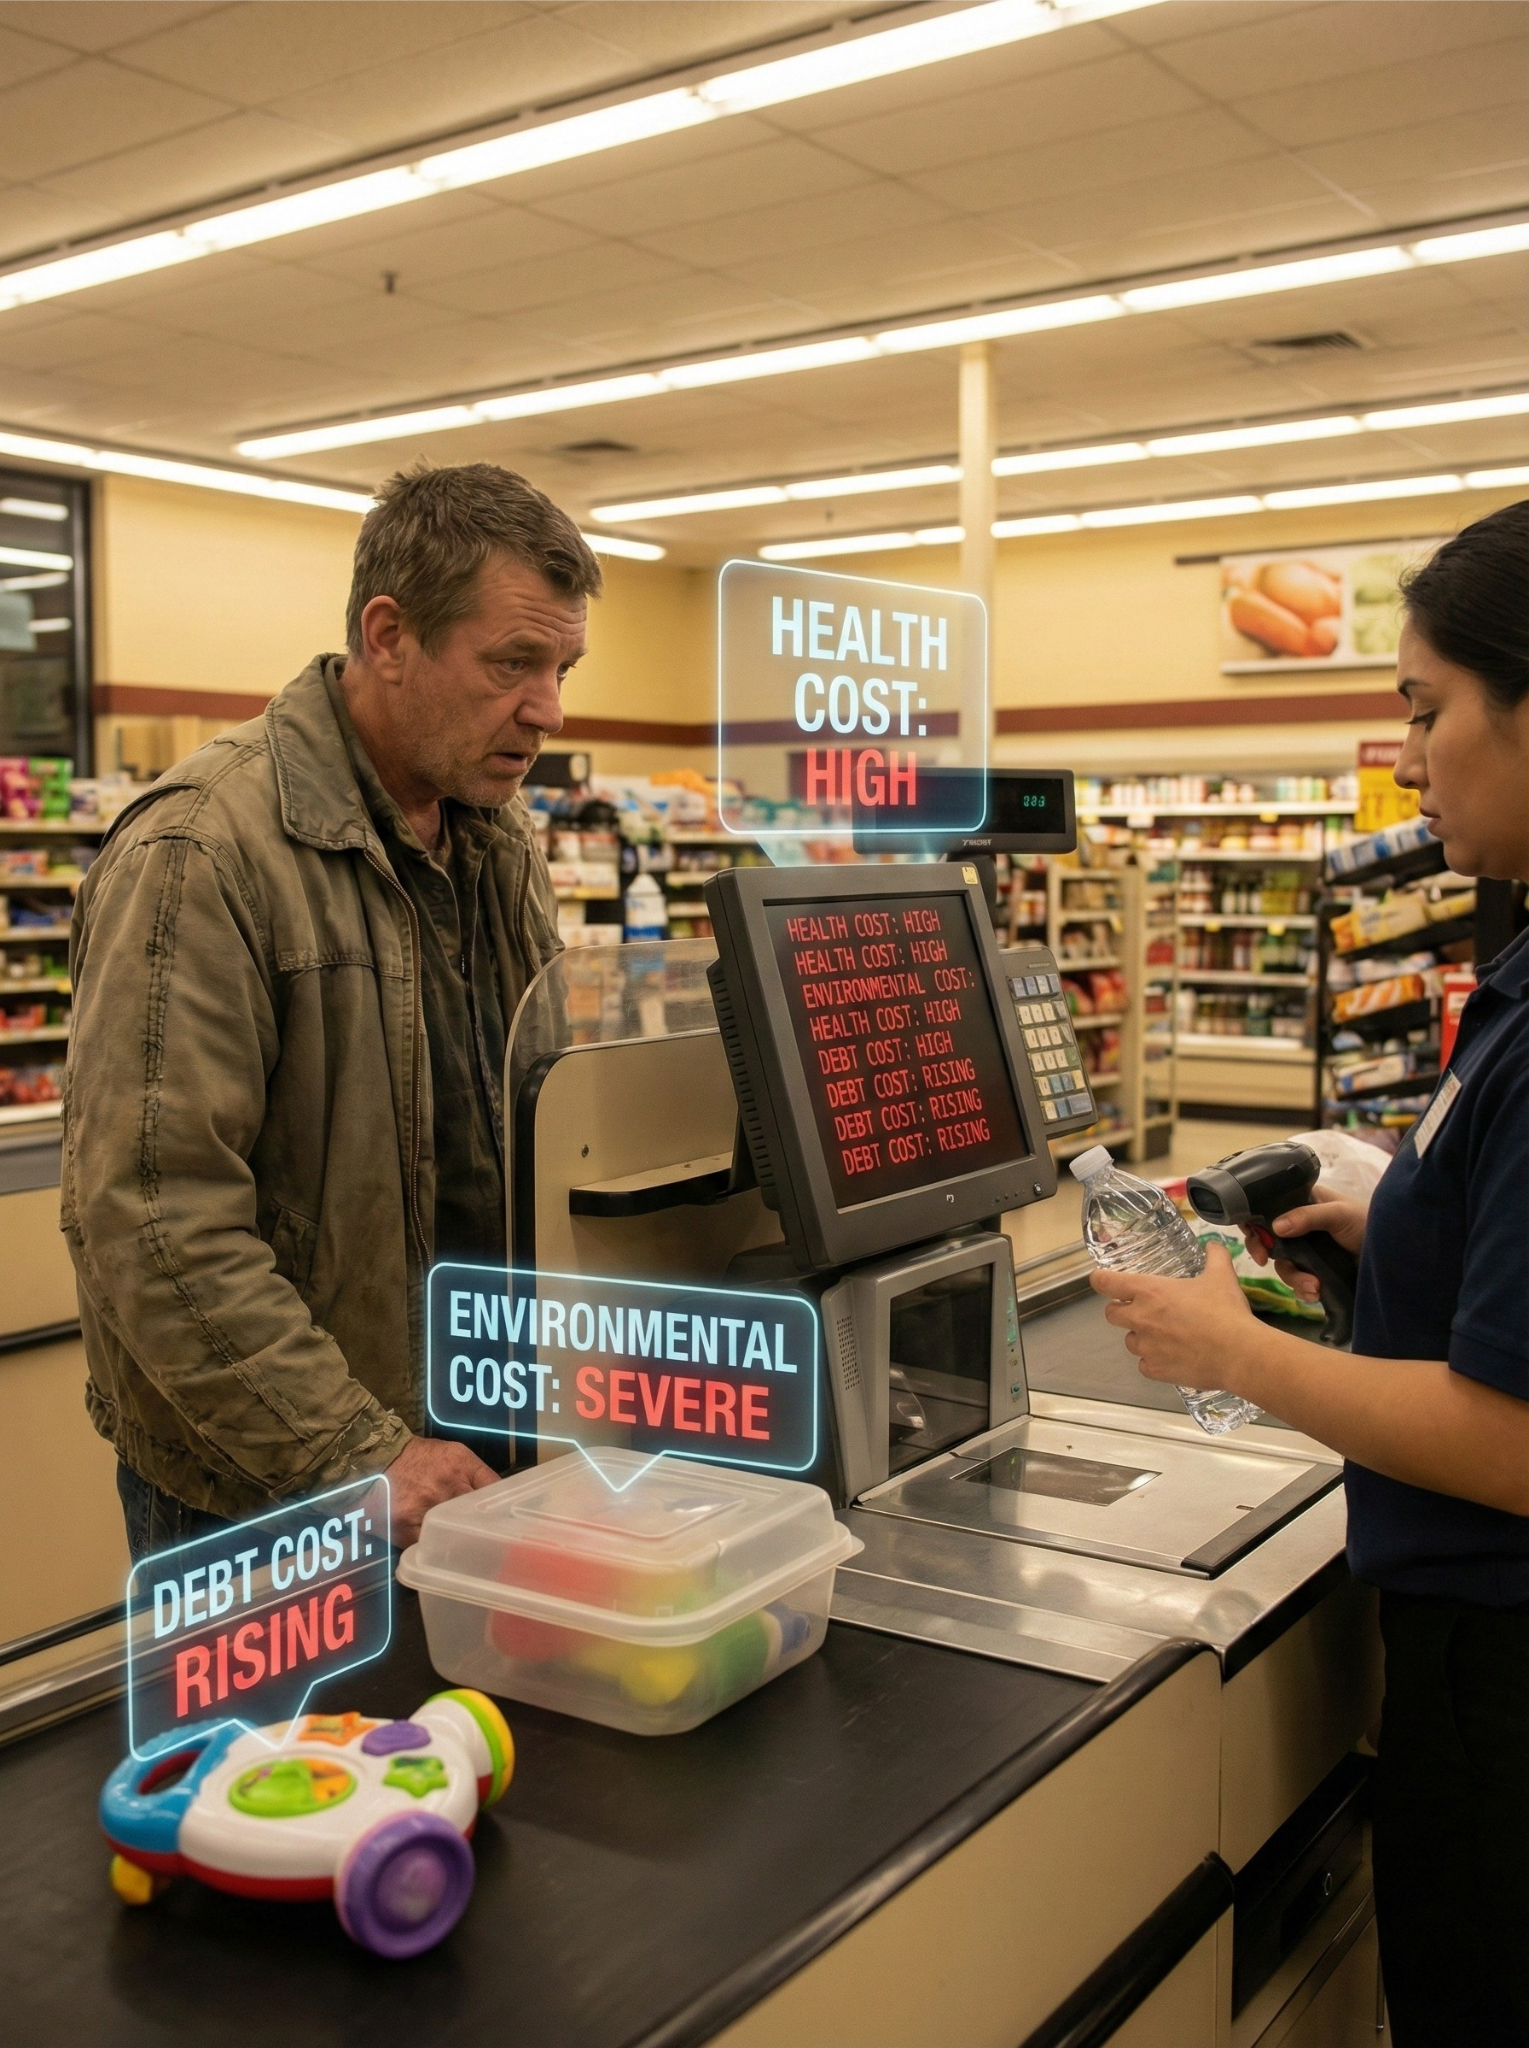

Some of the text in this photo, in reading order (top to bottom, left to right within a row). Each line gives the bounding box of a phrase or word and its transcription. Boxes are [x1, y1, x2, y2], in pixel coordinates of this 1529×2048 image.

[787, 910, 941, 942] HEALTH COST: HIGH
[794, 940, 949, 976] HEALTH COST: HIGH
[802, 967, 976, 1009] ENVIRONMENTAL COST:
[810, 999, 961, 1041] HEALTH COST: HIGH
[818, 1031, 954, 1075] DEBT COST: HIGH
[826, 1058, 976, 1109] DEBT COST: RISING
[834, 1088, 983, 1142] DEBT COST: RISING
[842, 1118, 991, 1176] DEBT COST: RISING
